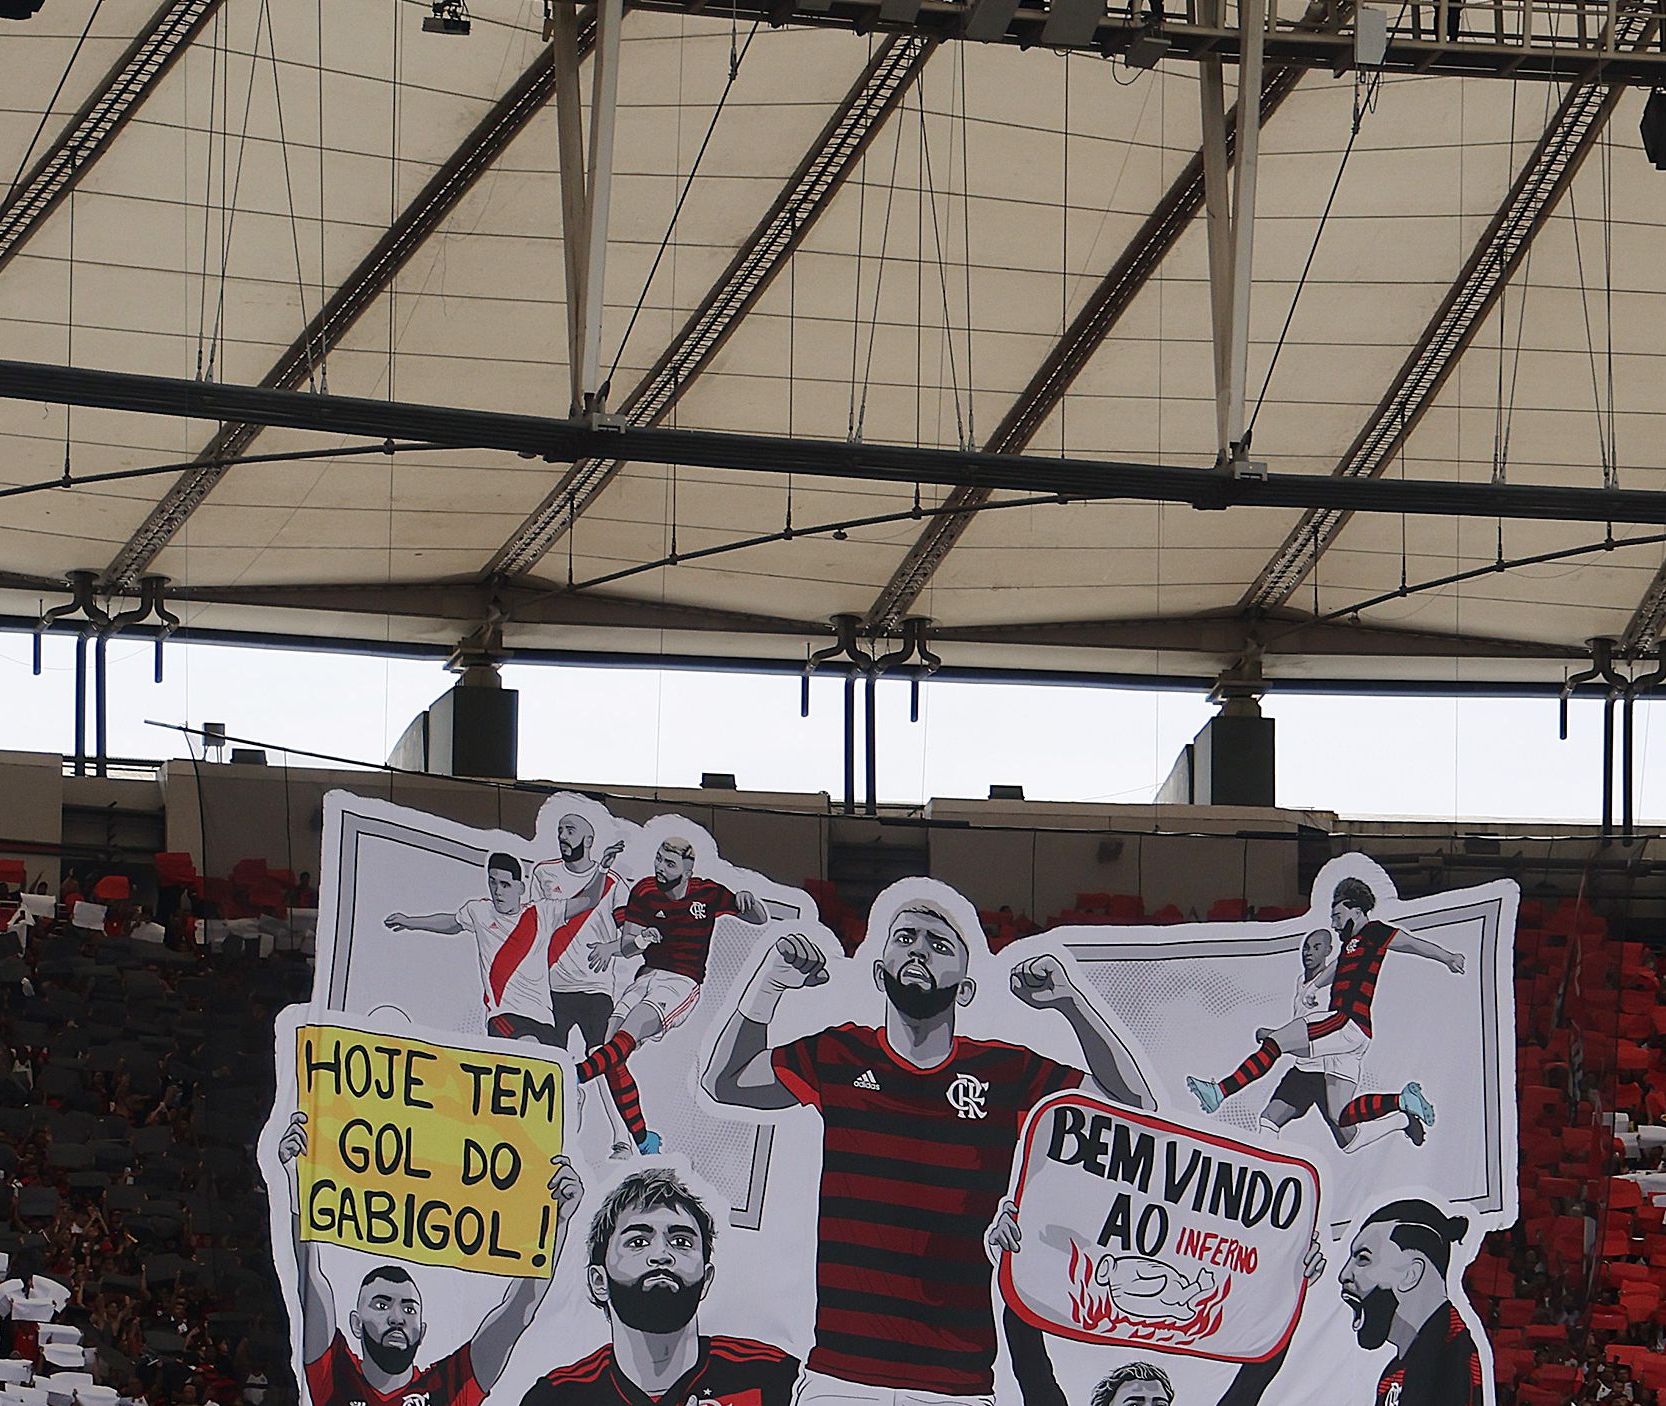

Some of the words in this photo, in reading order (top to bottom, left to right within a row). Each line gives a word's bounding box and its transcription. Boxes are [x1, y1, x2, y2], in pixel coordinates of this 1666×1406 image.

[305, 1039, 437, 1110] HOJE
[460, 1063, 555, 1122] TEM
[338, 1117, 431, 1179] GOL
[462, 1138, 522, 1191] DO
[1046, 1105, 1156, 1193] BEM
[1163, 1140, 1304, 1230] VINDO
[1096, 1193, 1169, 1256] AO
[1175, 1226, 1259, 1276] INFERNO
